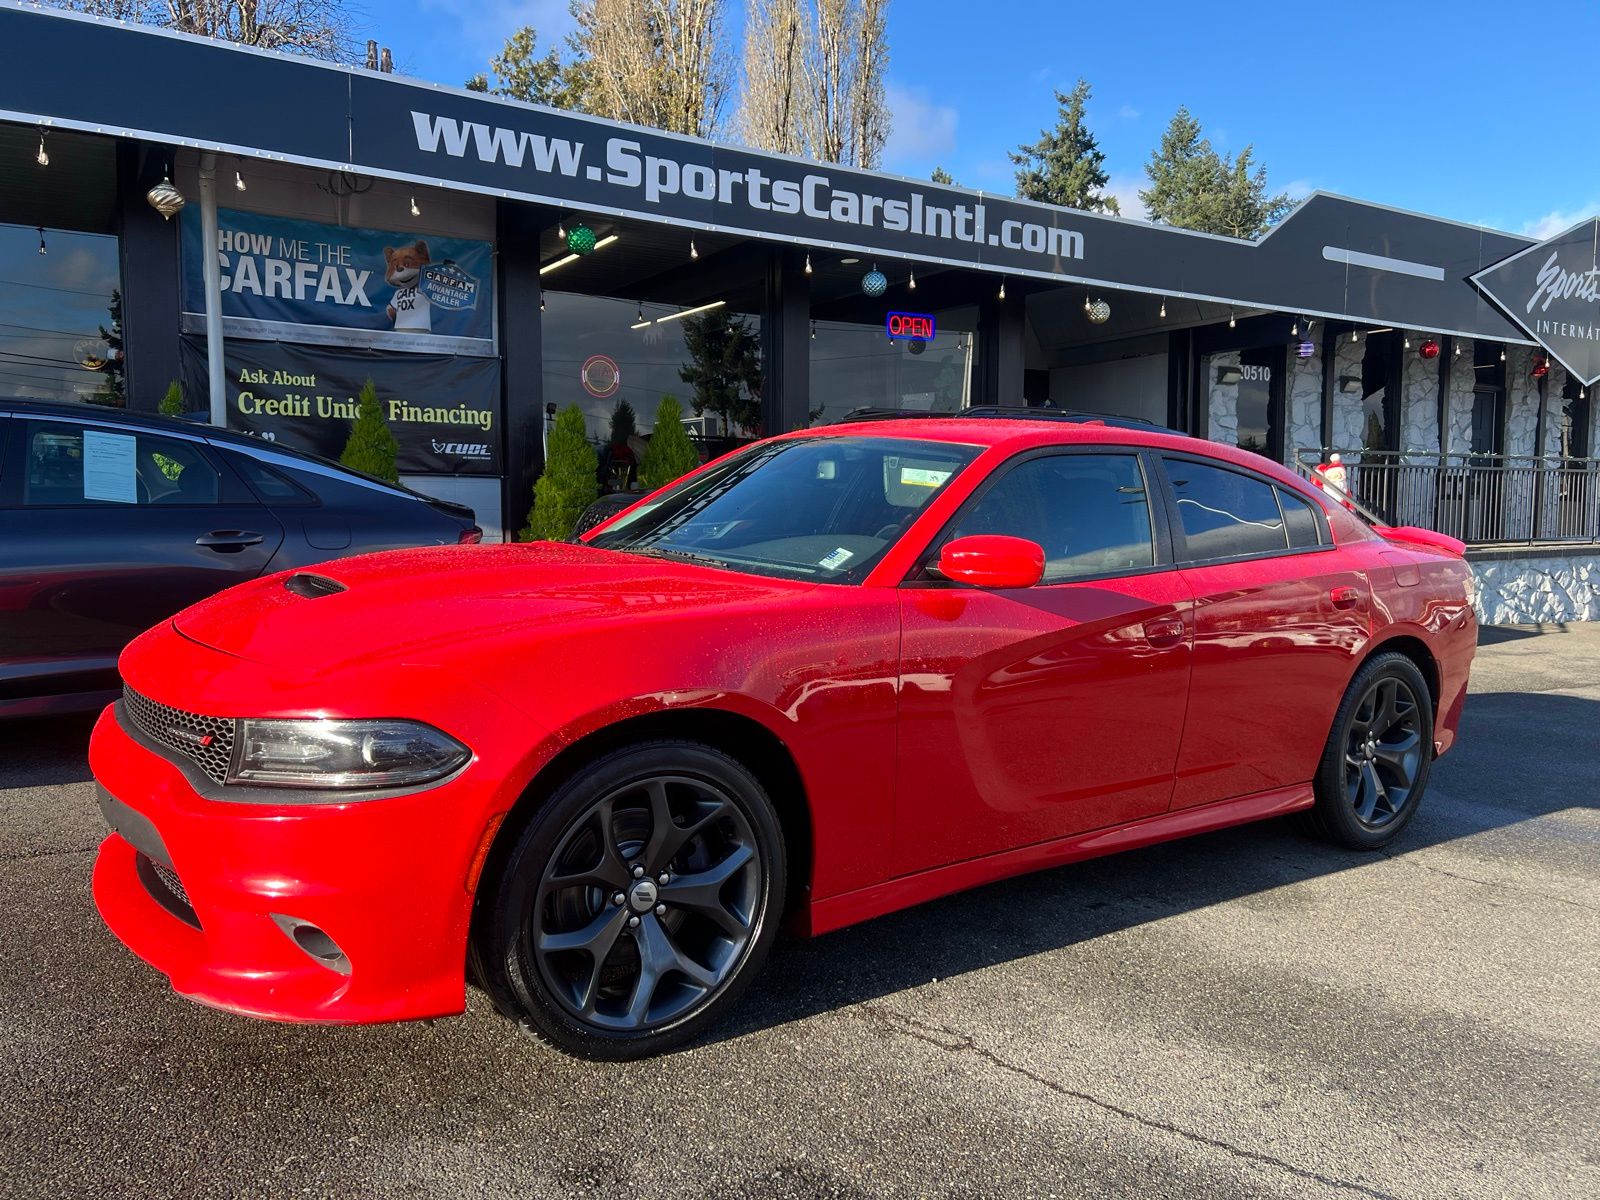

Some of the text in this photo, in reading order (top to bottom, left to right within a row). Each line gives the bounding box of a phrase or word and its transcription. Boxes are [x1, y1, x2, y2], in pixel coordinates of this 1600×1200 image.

[410, 110, 1084, 259] www.SportsCarsIntl.com
[218, 229, 351, 266] HOW ME THE
[426, 271, 474, 292] CARFAX
[427, 282, 469, 301] ADVANTAGE
[396, 287, 416, 298] CAR
[431, 292, 460, 307] DEALER
[396, 298, 415, 312] FOX
[888, 314, 933, 338] OPEN
[239, 368, 316, 387] Ask About
[238, 391, 493, 431] Credit Unio Financing
